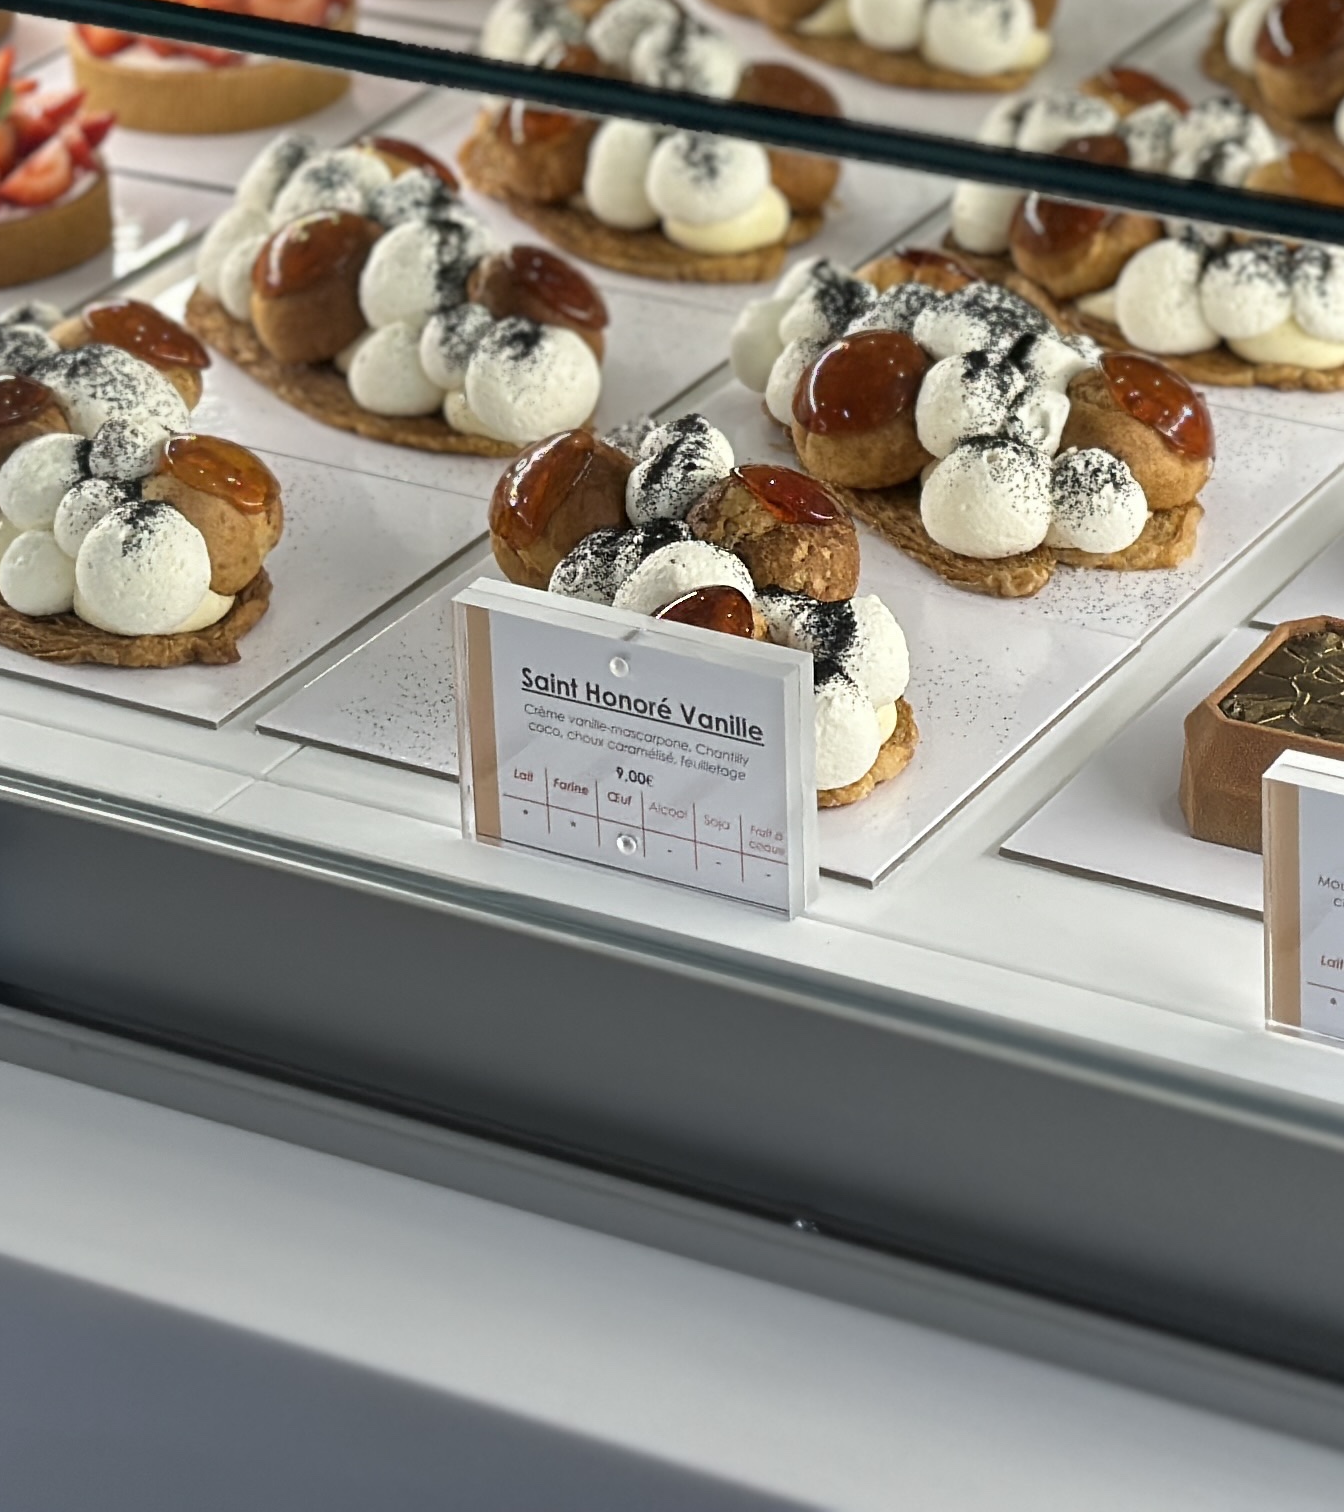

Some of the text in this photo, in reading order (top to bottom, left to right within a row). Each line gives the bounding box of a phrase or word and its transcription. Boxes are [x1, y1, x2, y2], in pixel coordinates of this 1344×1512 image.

[521, 668, 764, 742] Saint Honoré Vanille
[524, 704, 565, 723] Crème
[569, 714, 692, 752] vanille-mascarpone,
[528, 721, 747, 782] coco, choux caramélisé, feuilletage
[513, 768, 534, 783] Lait
[553, 777, 588, 796] Farine
[607, 792, 633, 806] Œuf
[1320, 955, 1344, 970] Lait
